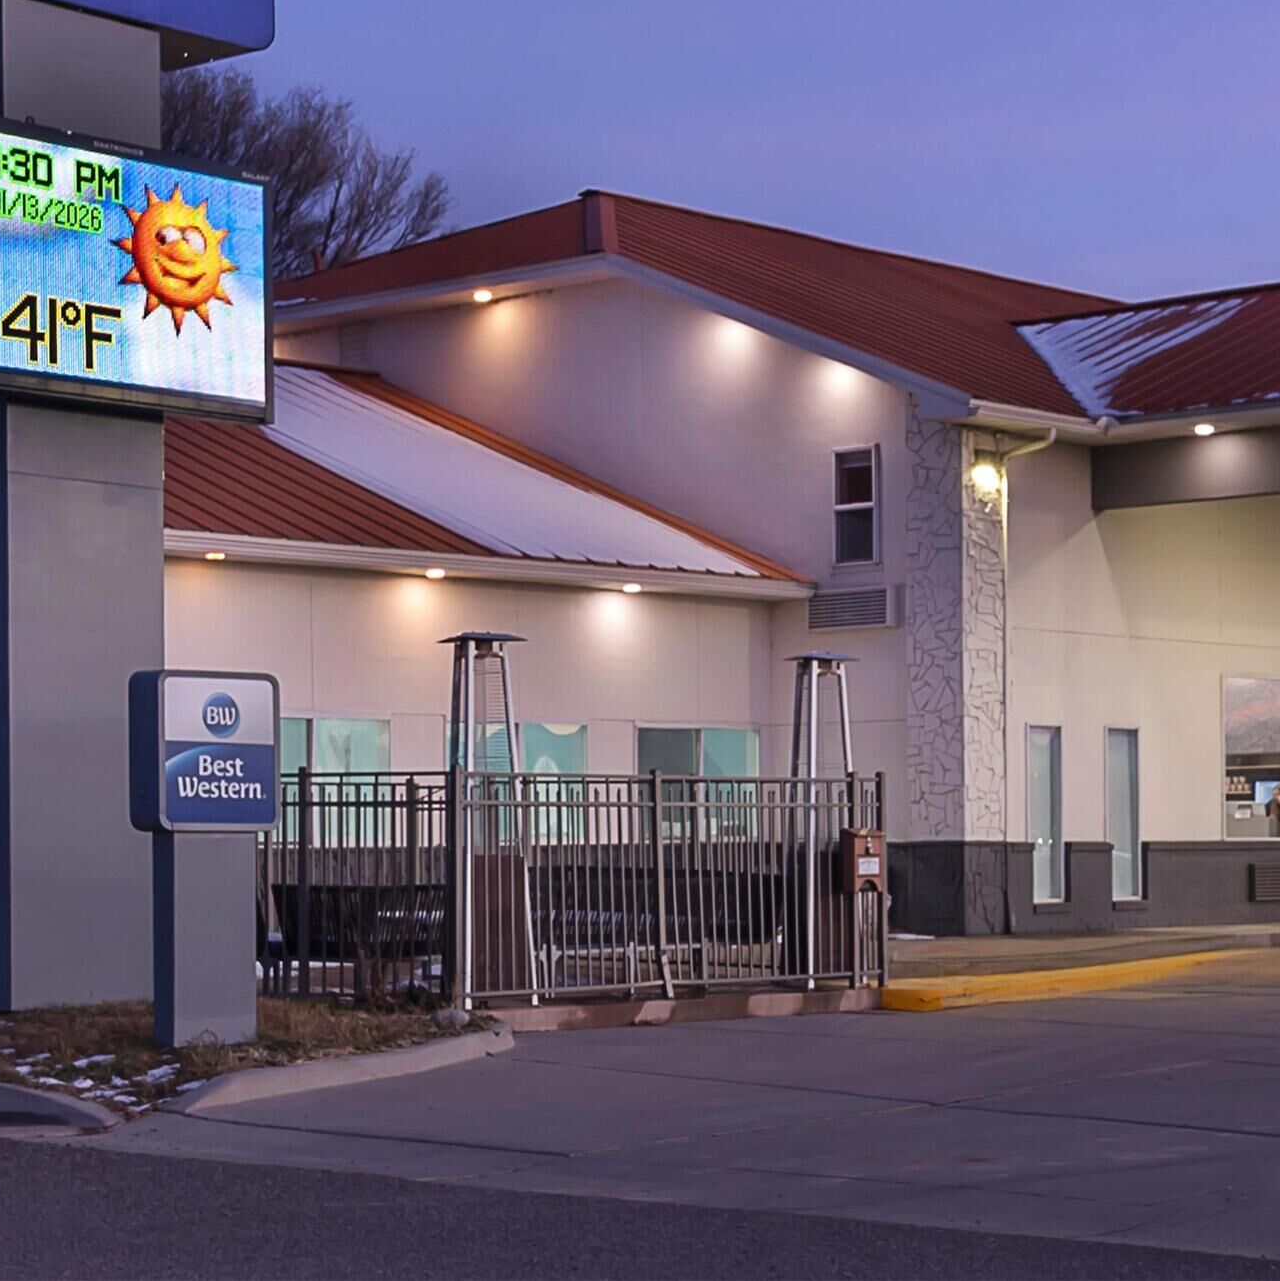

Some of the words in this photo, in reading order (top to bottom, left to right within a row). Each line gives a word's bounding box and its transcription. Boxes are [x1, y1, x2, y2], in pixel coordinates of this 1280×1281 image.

[75, 159, 122, 202] PM
[0, 293, 122, 372] 41°F
[206, 706, 236, 725] BW
[198, 755, 244, 777] Best
